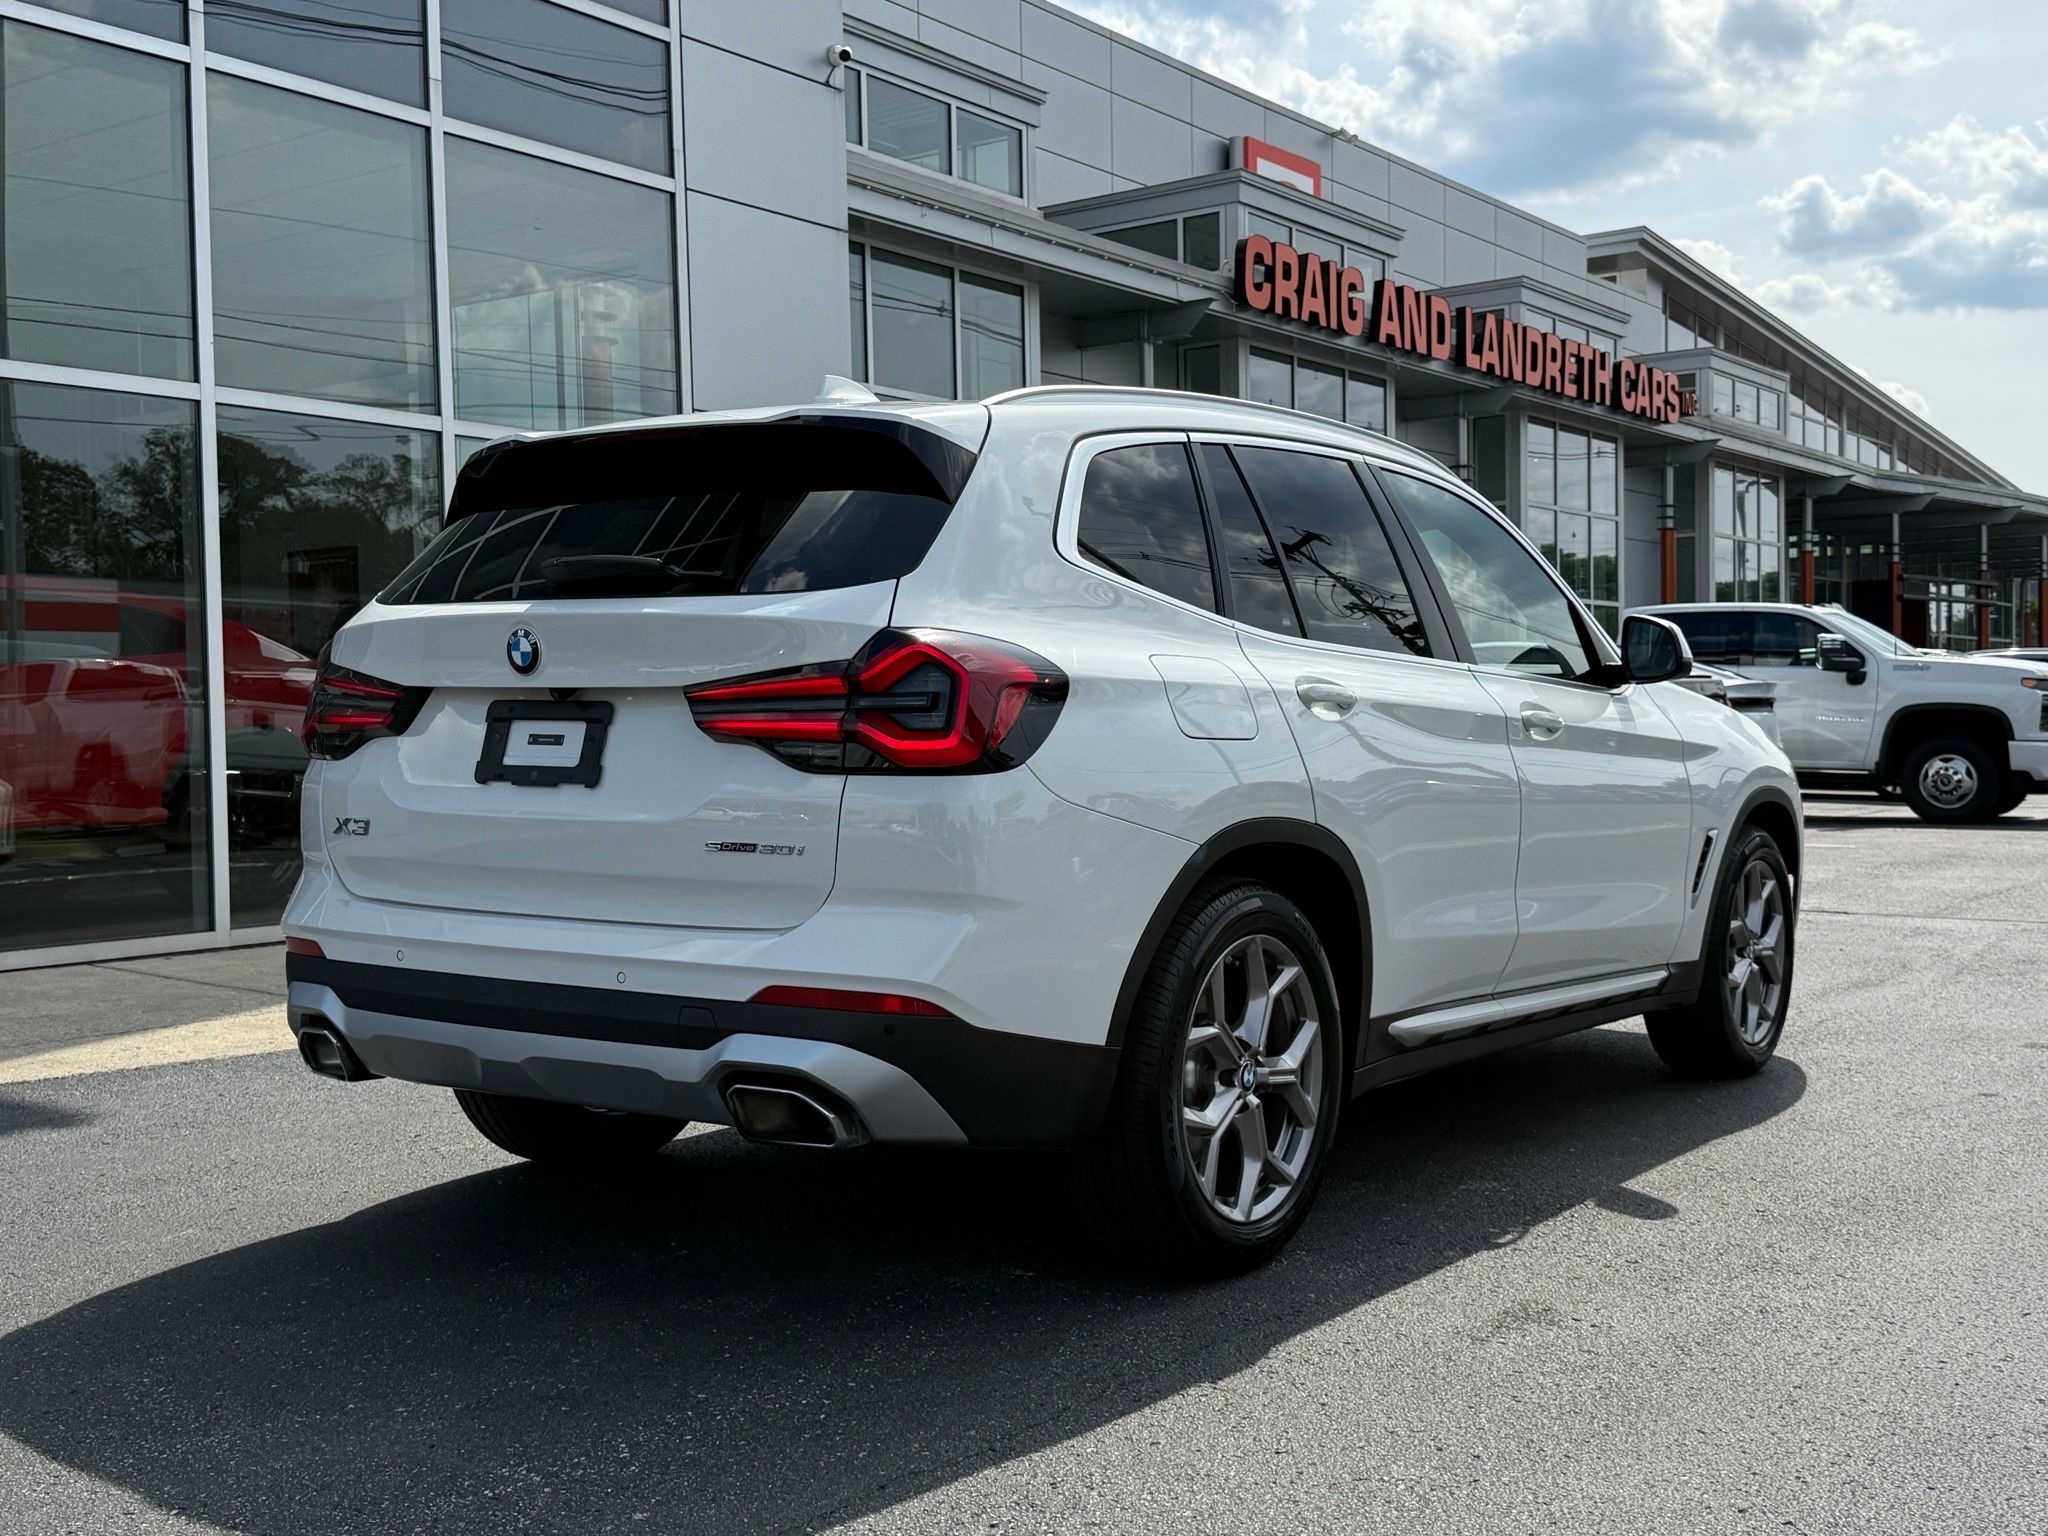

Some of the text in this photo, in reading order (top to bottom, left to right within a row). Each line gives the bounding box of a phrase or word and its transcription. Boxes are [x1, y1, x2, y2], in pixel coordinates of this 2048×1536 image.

[1244, 233, 1366, 337] CRAIG
[1378, 278, 1453, 361] AND
[1464, 305, 1611, 406] LANDRETH
[1620, 357, 1680, 425] CARS
[332, 816, 371, 836] X3
